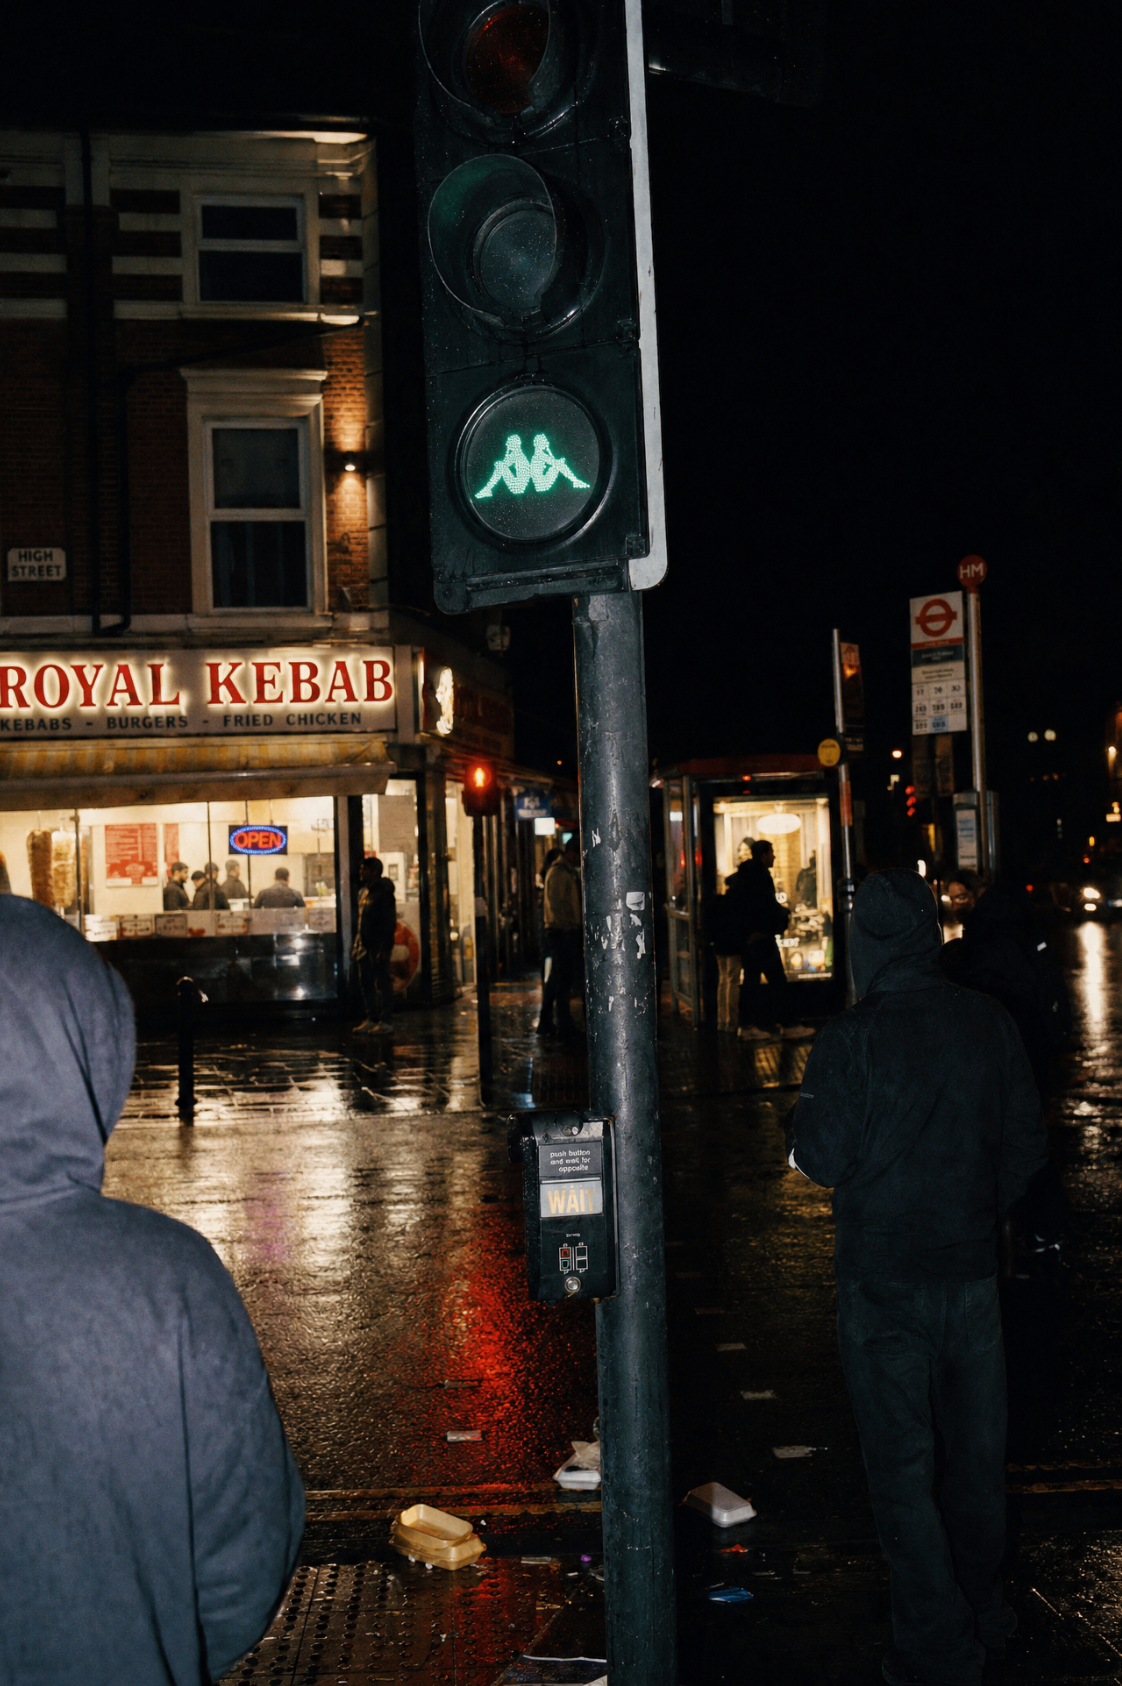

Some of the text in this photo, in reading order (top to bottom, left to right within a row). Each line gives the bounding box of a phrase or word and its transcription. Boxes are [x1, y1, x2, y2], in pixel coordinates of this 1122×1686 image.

[18, 550, 54, 562] HIGH
[11, 565, 62, 577] STREET
[960, 563, 984, 579] HM
[0, 660, 393, 708] ROYAL KEBAB
[0, 717, 73, 732] KEBABS
[106, 715, 189, 729] BURGERS
[223, 714, 274, 727] FRIED
[286, 712, 362, 726] CHICKEN
[234, 831, 283, 849] OPEN
[568, 1149, 591, 1157] button
[547, 1189, 596, 1215] WAIT
